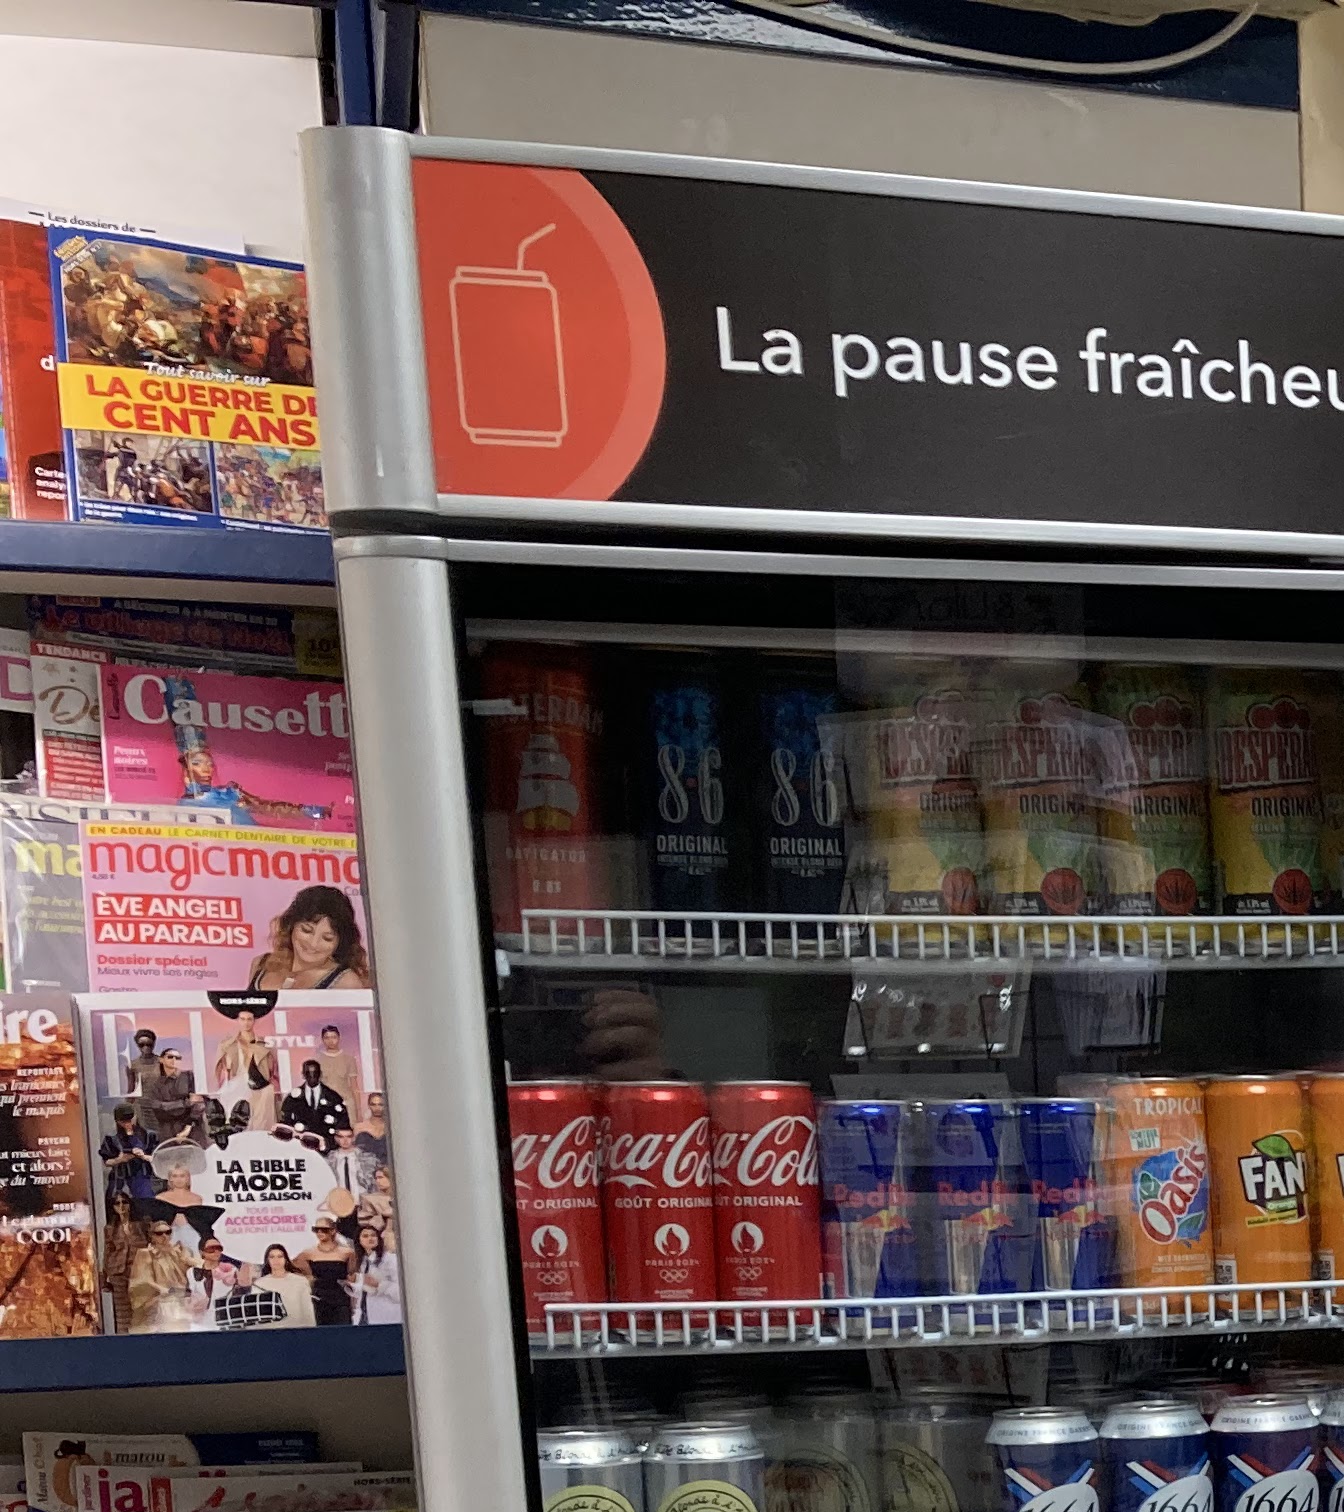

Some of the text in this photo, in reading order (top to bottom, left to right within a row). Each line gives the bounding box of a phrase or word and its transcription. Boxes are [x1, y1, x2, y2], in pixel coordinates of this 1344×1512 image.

[48, 211, 136, 233] Les dossiers de
[716, 306, 803, 375] La
[832, 329, 1058, 396] pause
[145, 362, 185, 379] Tout
[86, 375, 273, 414] LA GUERRE
[104, 401, 317, 447] CENT ANS
[657, 835, 728, 854] ORIGINAL
[150, 897, 238, 920] ANGELI
[99, 922, 249, 946] AU PARADIS
[216, 1158, 306, 1174] LA BIBLE
[223, 1173, 303, 1192] MODE
[215, 1191, 312, 1203] DE LA SAISON
[1140, 1147, 1207, 1244] Oasis
